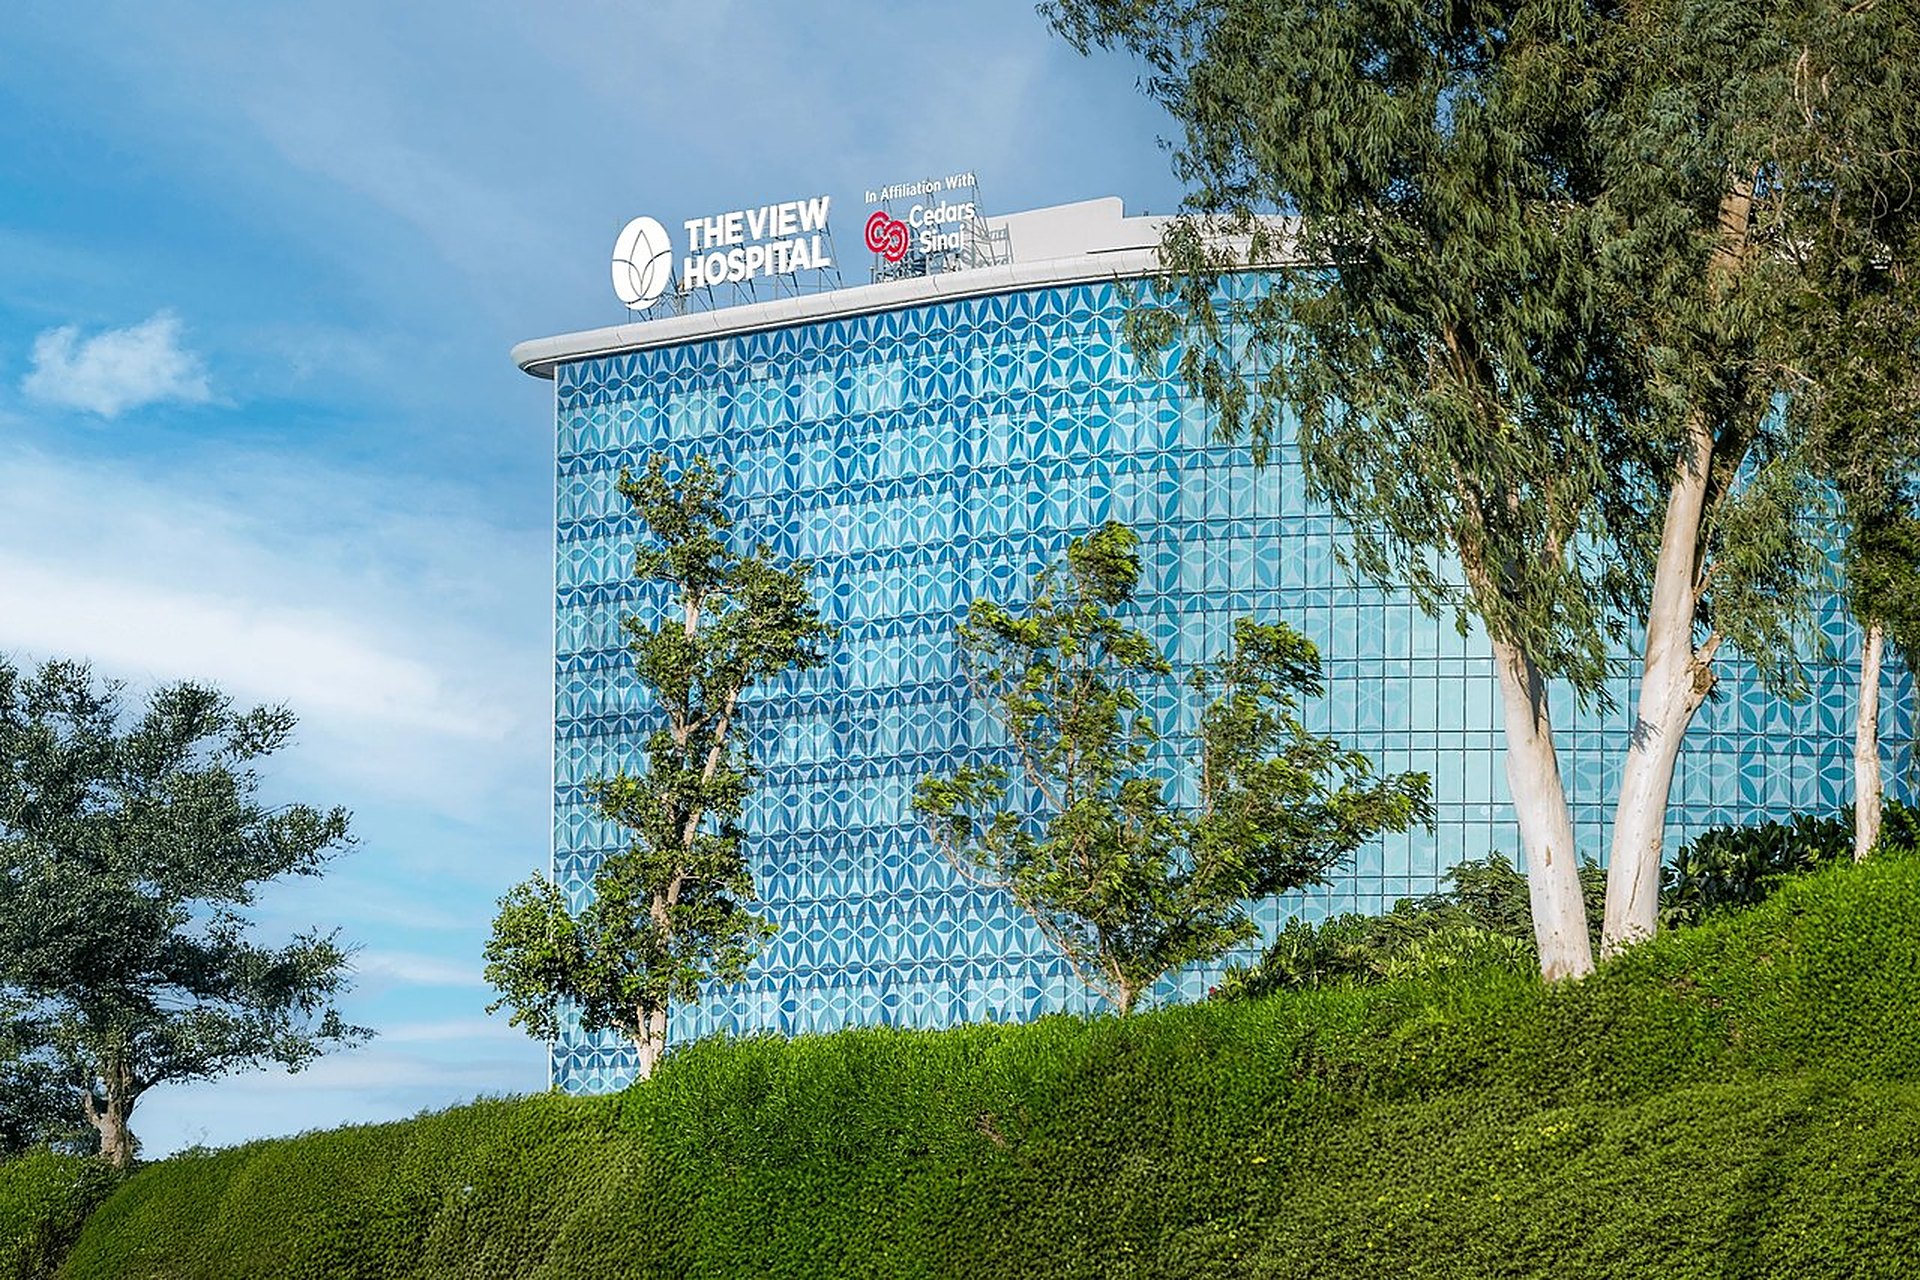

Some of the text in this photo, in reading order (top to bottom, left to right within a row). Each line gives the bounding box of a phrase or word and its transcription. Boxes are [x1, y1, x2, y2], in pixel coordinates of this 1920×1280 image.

[865, 172, 975, 203] In Affiliation With
[684, 195, 830, 252] THE VIEW
[909, 200, 975, 228] Cedars
[919, 223, 966, 253] Sinai
[683, 235, 831, 290] HOSPITAL
